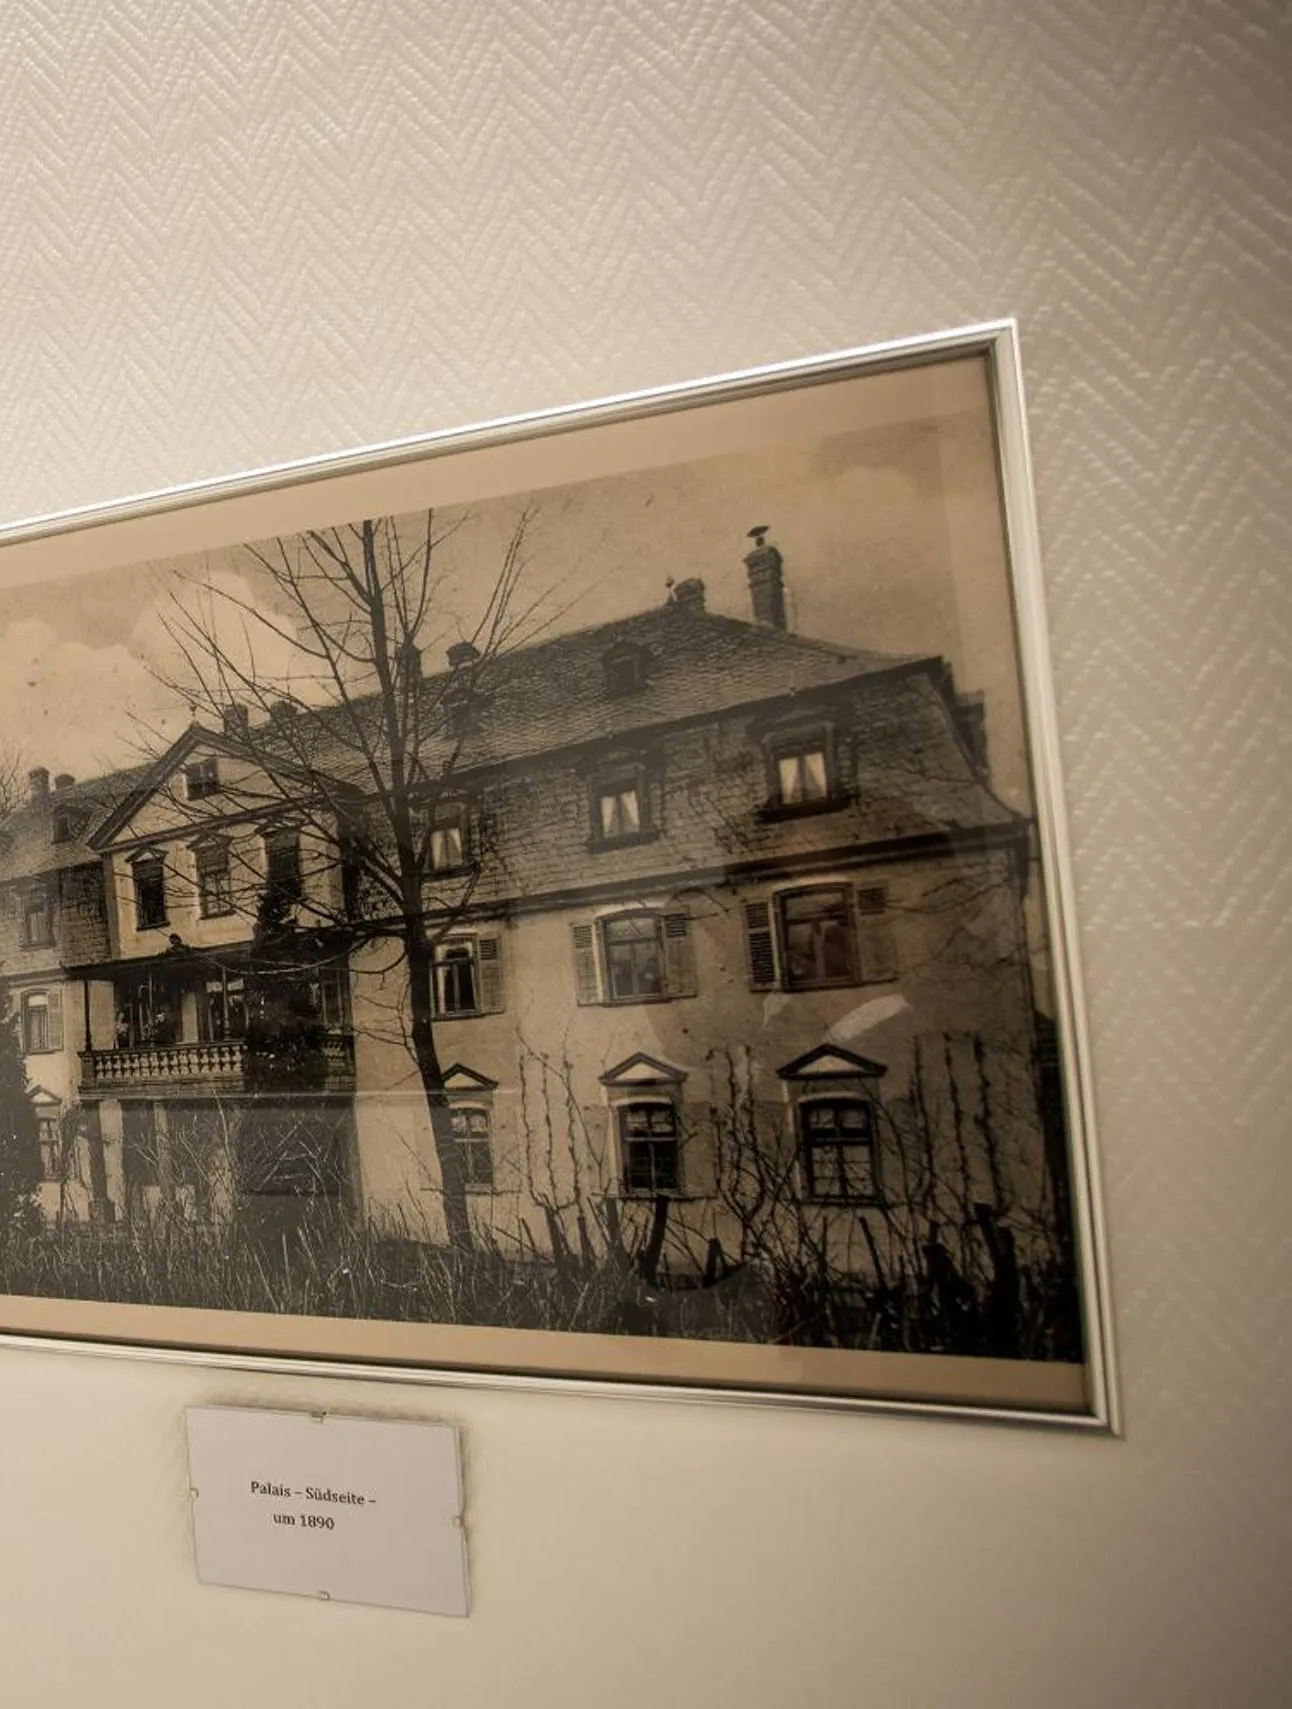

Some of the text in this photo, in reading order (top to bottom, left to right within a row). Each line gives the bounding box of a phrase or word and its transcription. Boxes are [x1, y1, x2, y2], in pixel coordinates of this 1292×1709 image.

[250, 1480, 291, 1498] Palais
[305, 1486, 365, 1505] Südseite
[273, 1513, 335, 1530] um 1890
